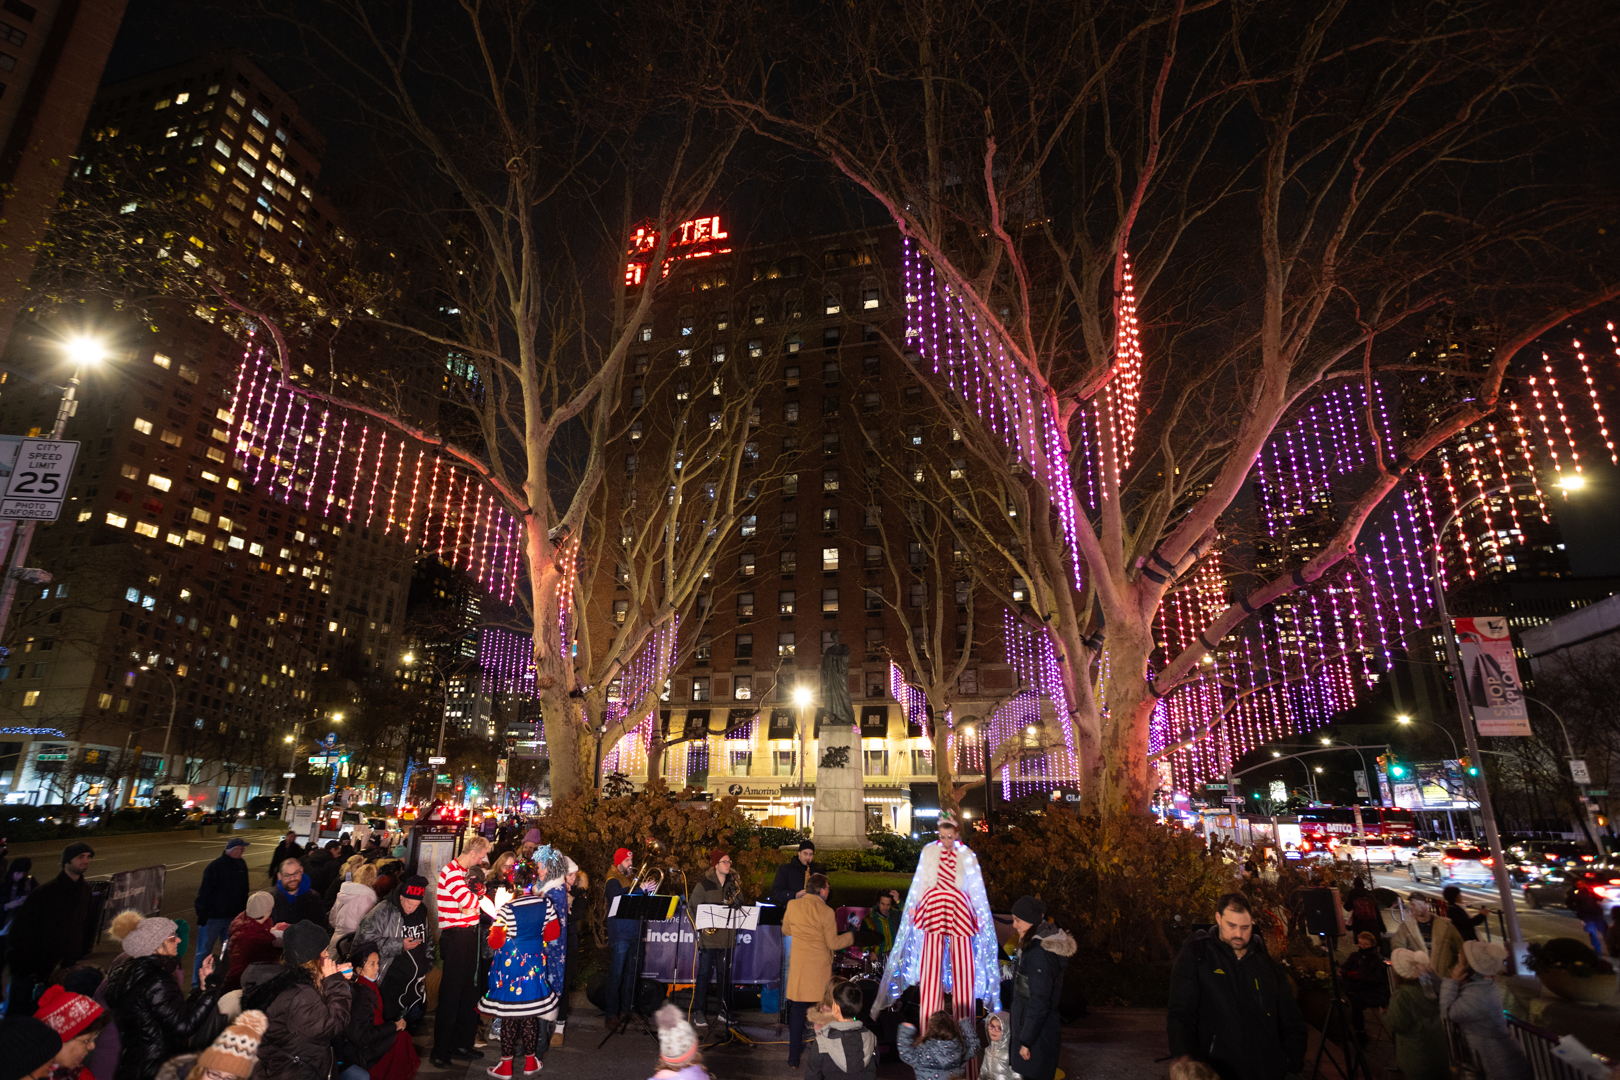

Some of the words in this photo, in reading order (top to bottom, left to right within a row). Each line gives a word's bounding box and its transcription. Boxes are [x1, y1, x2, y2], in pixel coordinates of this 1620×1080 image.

[14, 472, 61, 494] 25
[15, 501, 46, 510] PHOTO
[1487, 676, 1508, 717] SHOP
[1573, 769, 1587, 777] 25
[743, 786, 780, 796] Amorino
[1327, 823, 1353, 834] DATTCO
[642, 928, 694, 943] incoln
